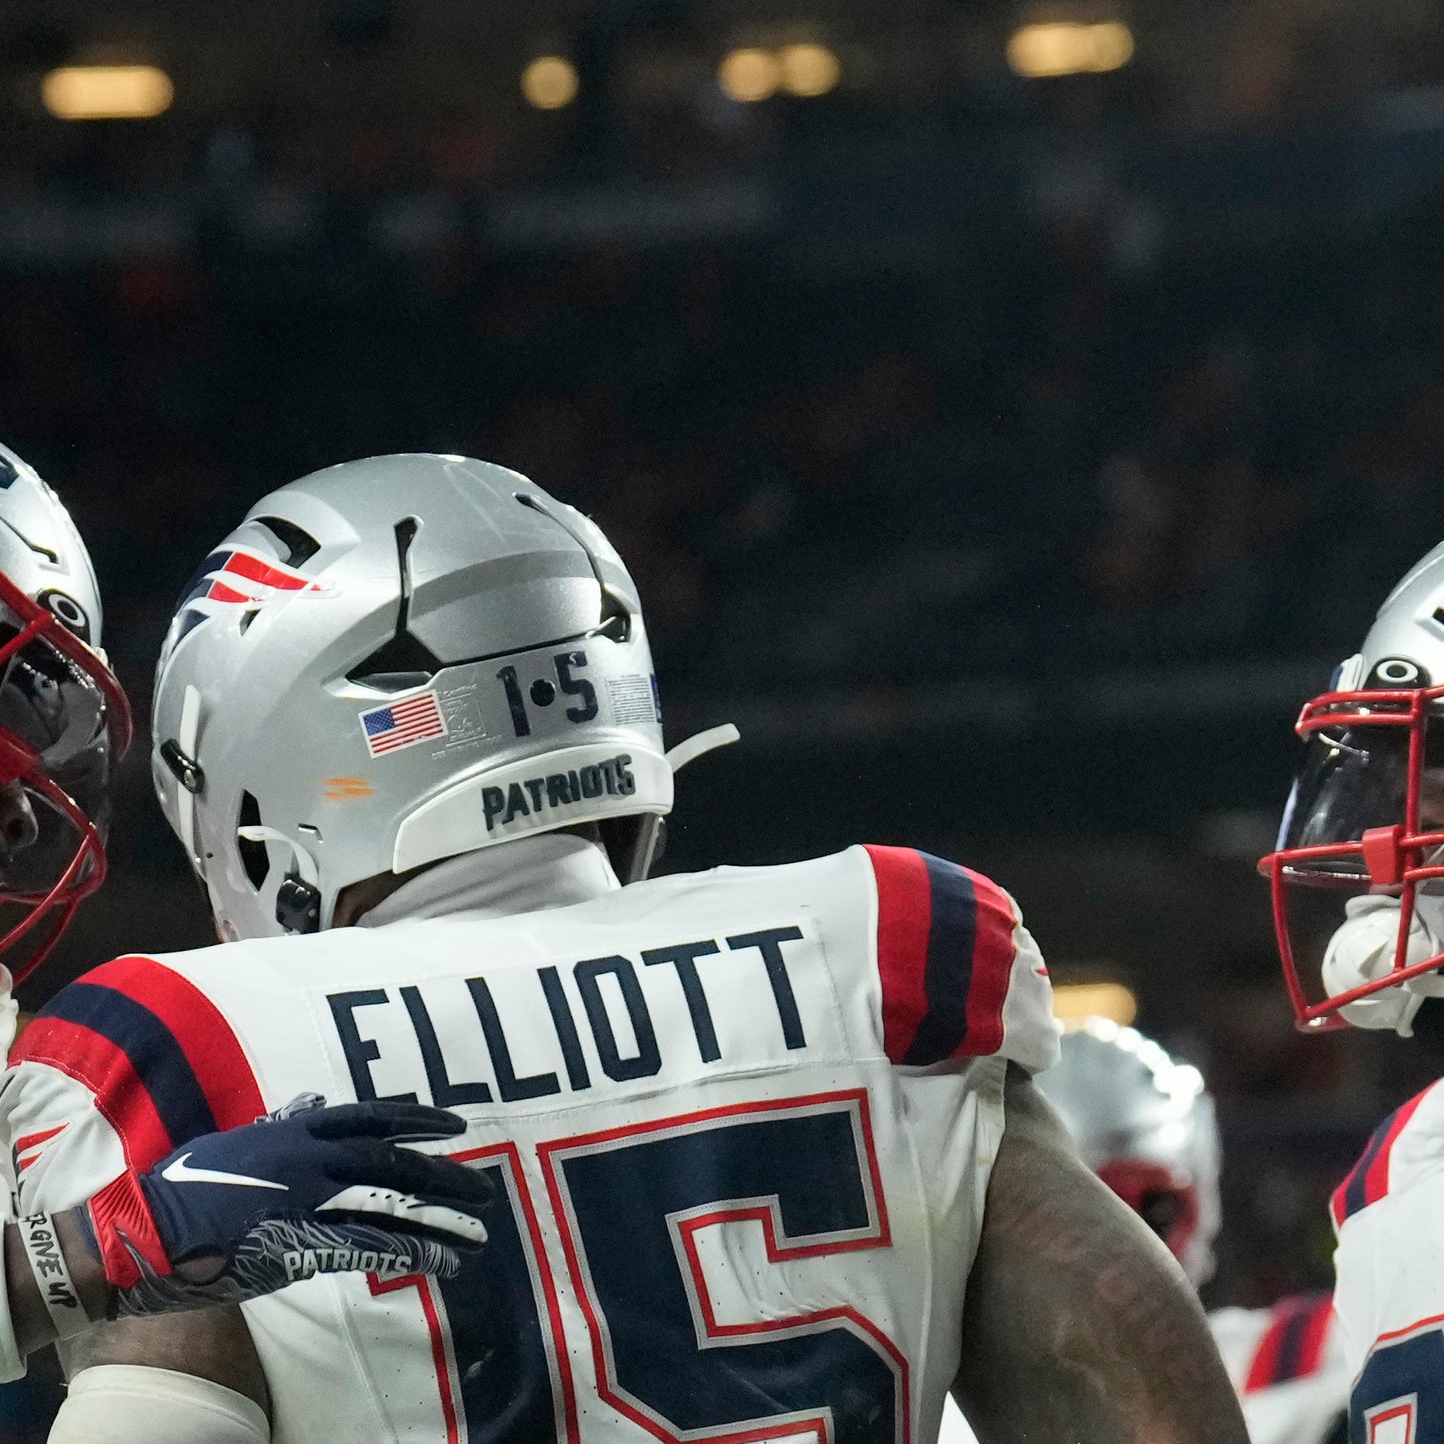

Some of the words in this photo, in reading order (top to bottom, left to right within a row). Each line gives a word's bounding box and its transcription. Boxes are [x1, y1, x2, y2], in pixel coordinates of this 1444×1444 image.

[481, 753, 636, 832] PATRIOTS
[326, 925, 806, 1105] ELLIOTT
[283, 1248, 412, 1281] PATRIOTS
